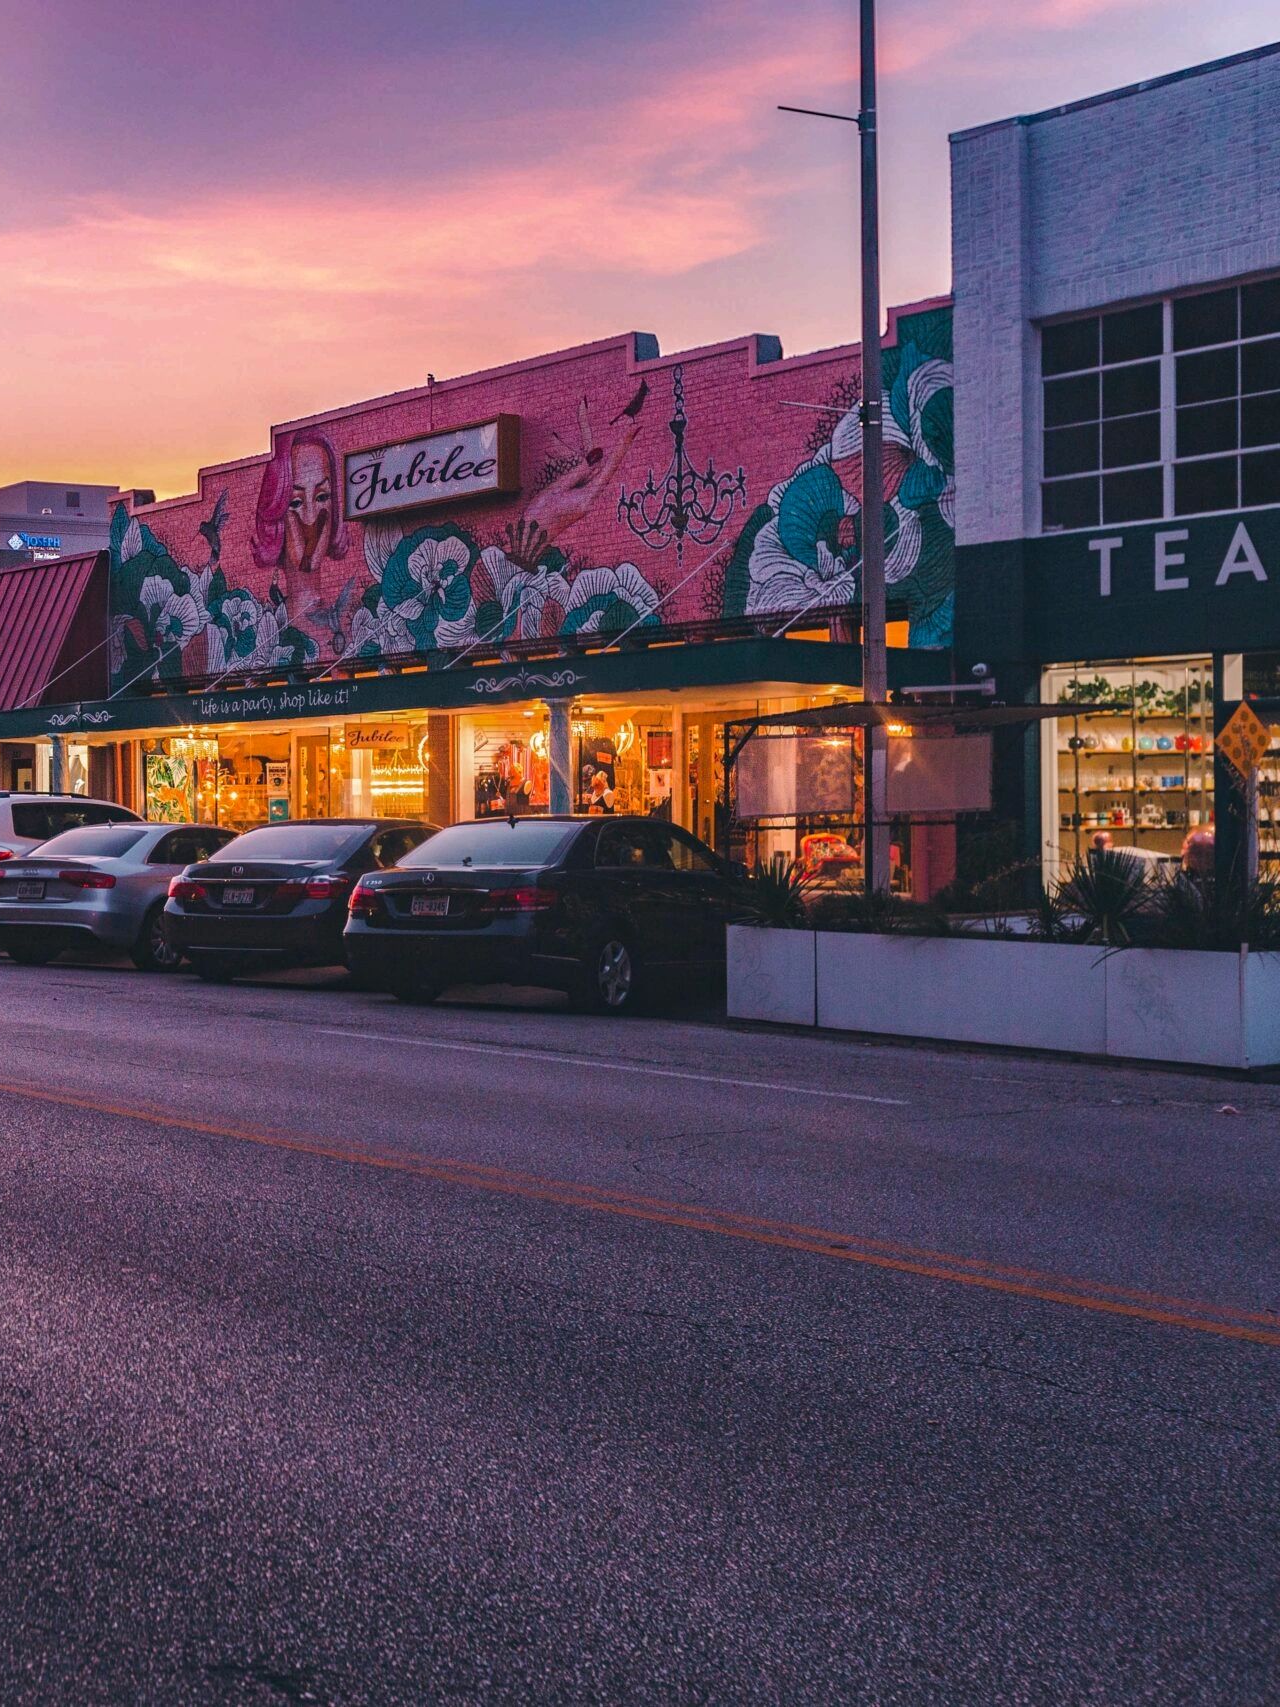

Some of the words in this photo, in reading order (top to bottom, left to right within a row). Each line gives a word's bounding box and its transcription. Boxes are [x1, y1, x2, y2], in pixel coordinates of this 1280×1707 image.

[349, 445, 497, 511] Jubilee
[26, 536, 61, 548] JOSEPH
[1088, 521, 1269, 597] TEA
[221, 701, 232, 714] is
[231, 700, 241, 713] a
[241, 695, 276, 718] party,
[280, 691, 305, 713] shop
[308, 689, 332, 707] like
[347, 728, 405, 747] Jubilee
